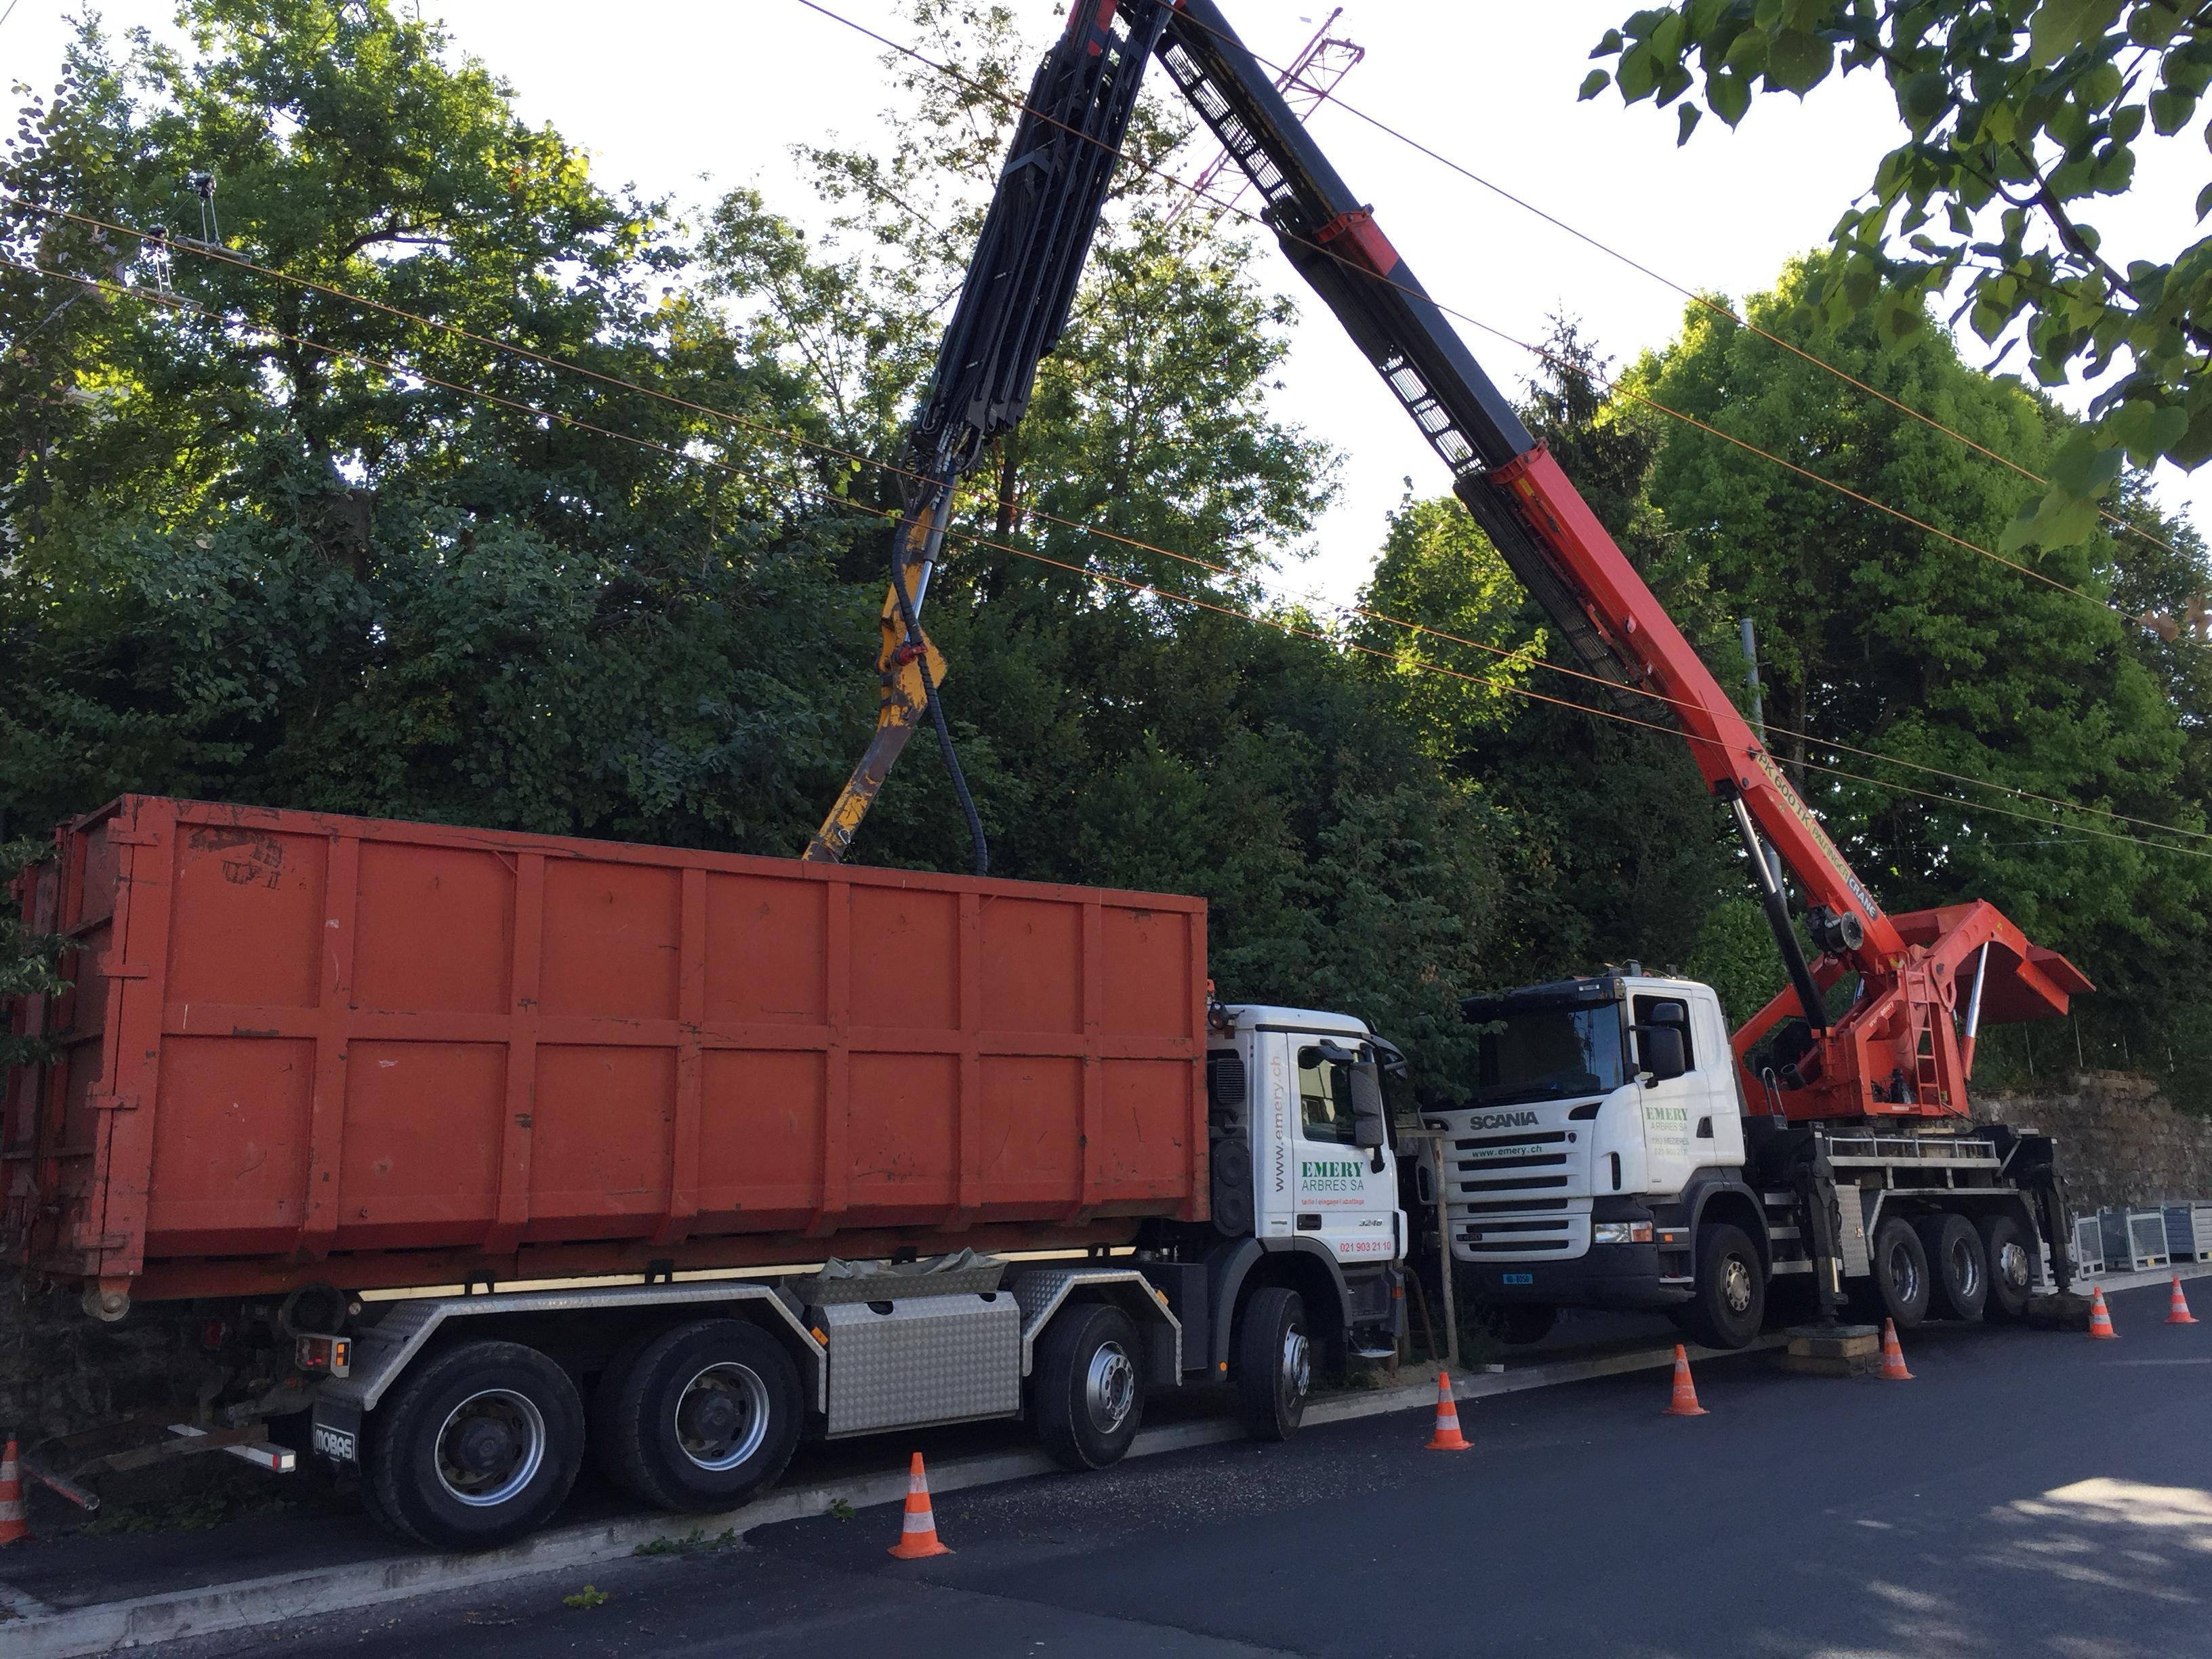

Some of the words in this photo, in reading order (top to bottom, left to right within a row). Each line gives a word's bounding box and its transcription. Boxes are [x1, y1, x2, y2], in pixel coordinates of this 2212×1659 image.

[1759, 754, 1774, 777] PK
[1775, 775, 1795, 806] 600
[1797, 802, 1810, 827] TK
[1812, 827, 1849, 880] PALFINGER
[1849, 878, 1876, 917] CRANE
[1470, 1111, 1540, 1130] SCANIA
[1645, 1107, 1688, 1121] EMERY
[1271, 1055, 1284, 1192] www.emery.ch
[1651, 1122, 1677, 1131] ARBRES
[1679, 1123, 1688, 1132] SA
[1472, 1145, 1542, 1158] www.emery.ch
[1302, 1162, 1364, 1177] EMERY
[1302, 1179, 1347, 1191] ARBRES
[1350, 1179, 1364, 1191] SA
[1340, 1243, 1354, 1252] 021
[1356, 1242, 1370, 1252] 903
[1372, 1242, 1381, 1251] 21
[1382, 1241, 1391, 1250] 10
[315, 1429, 352, 1459] MOBAS
